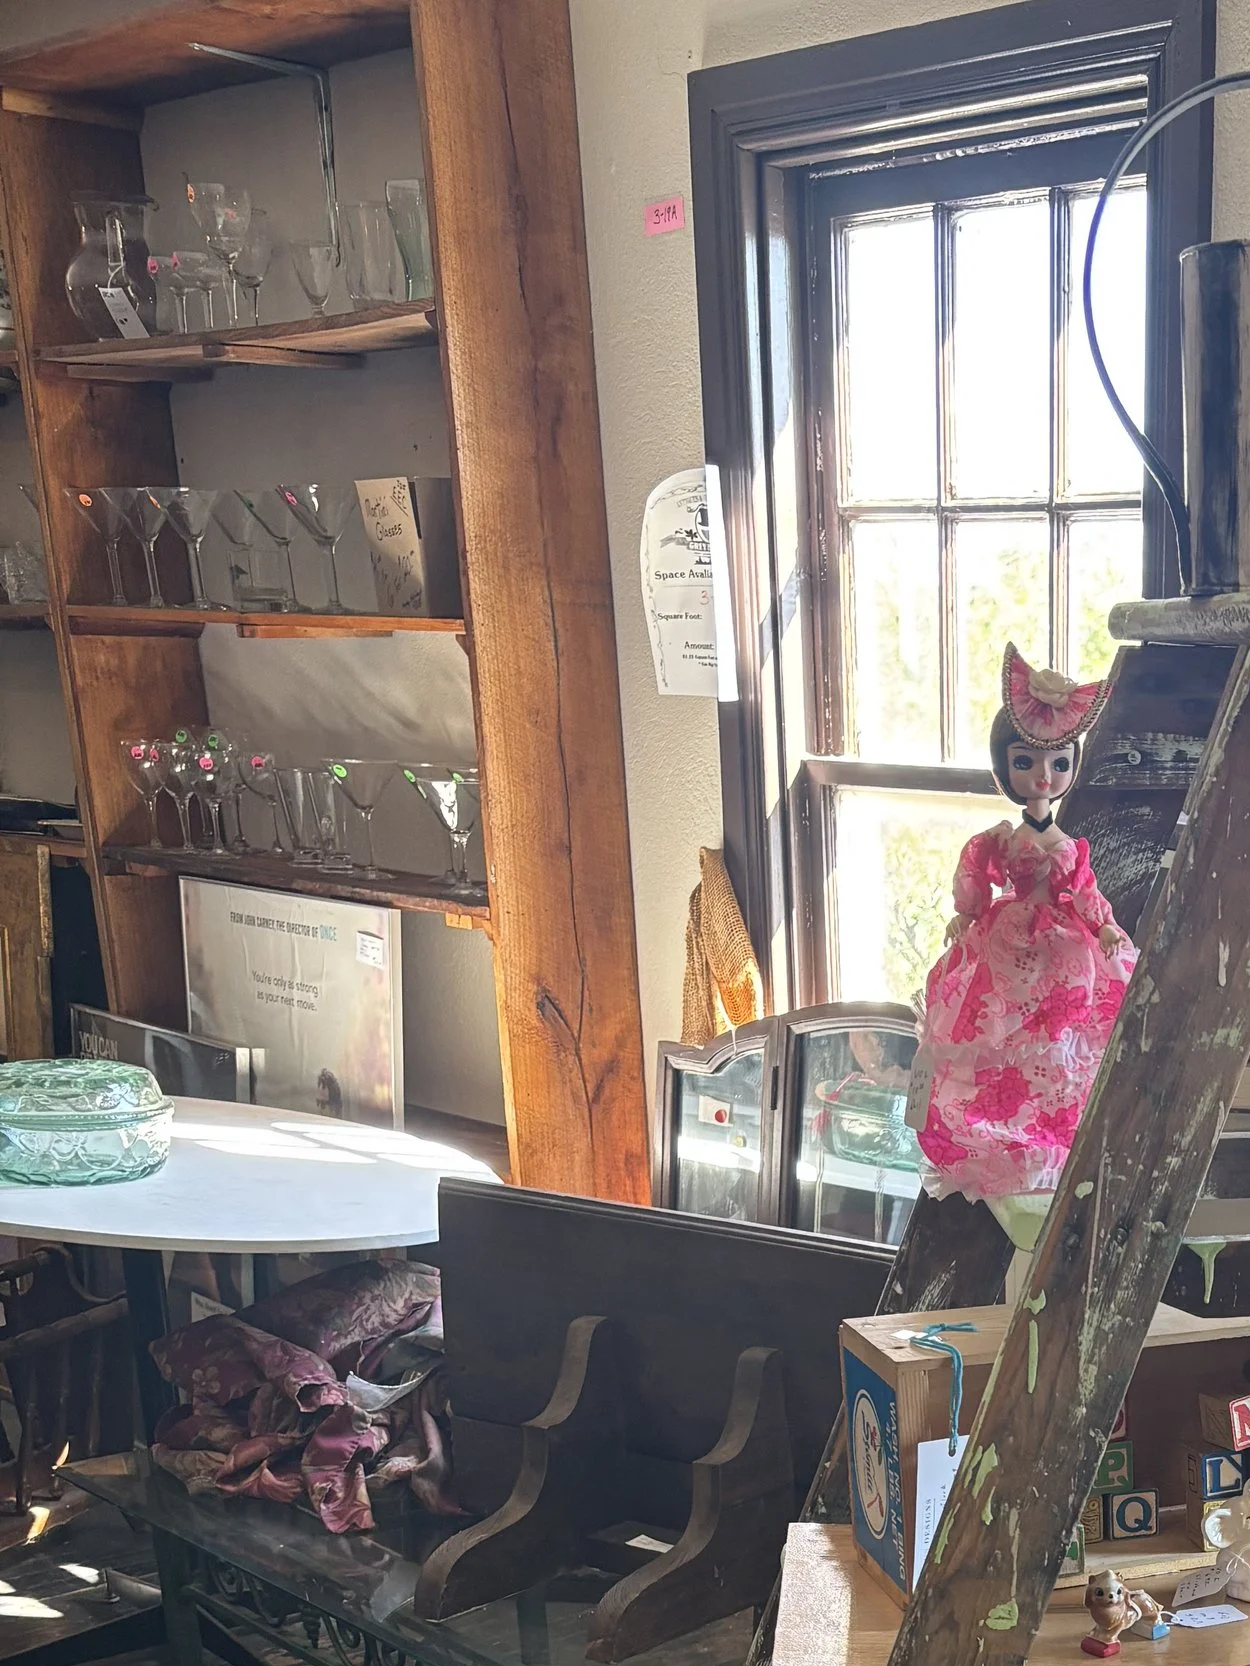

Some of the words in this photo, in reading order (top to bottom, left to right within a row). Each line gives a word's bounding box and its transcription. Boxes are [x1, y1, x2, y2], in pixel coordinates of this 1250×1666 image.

[654, 571, 686, 582] Space
[657, 612, 683, 622] Square
[230, 911, 244, 924] FROM
[244, 914, 256, 926] JOHN
[276, 919, 286, 932] THE
[286, 922, 311, 937] DIRECTOR
[311, 925, 319, 938] OF
[319, 924, 337, 942] ONCE
[251, 969, 272, 986] You're
[272, 976, 287, 992] only
[287, 980, 295, 990] as
[296, 980, 318, 998] strong
[256, 990, 265, 1000] as
[265, 991, 280, 1004] your
[1095, 1452, 1126, 1486] P
[1207, 1458, 1241, 1493] L
[889, 1510, 900, 1547] NET
[1115, 1496, 1153, 1534] Q
[897, 1529, 906, 1581] BING
